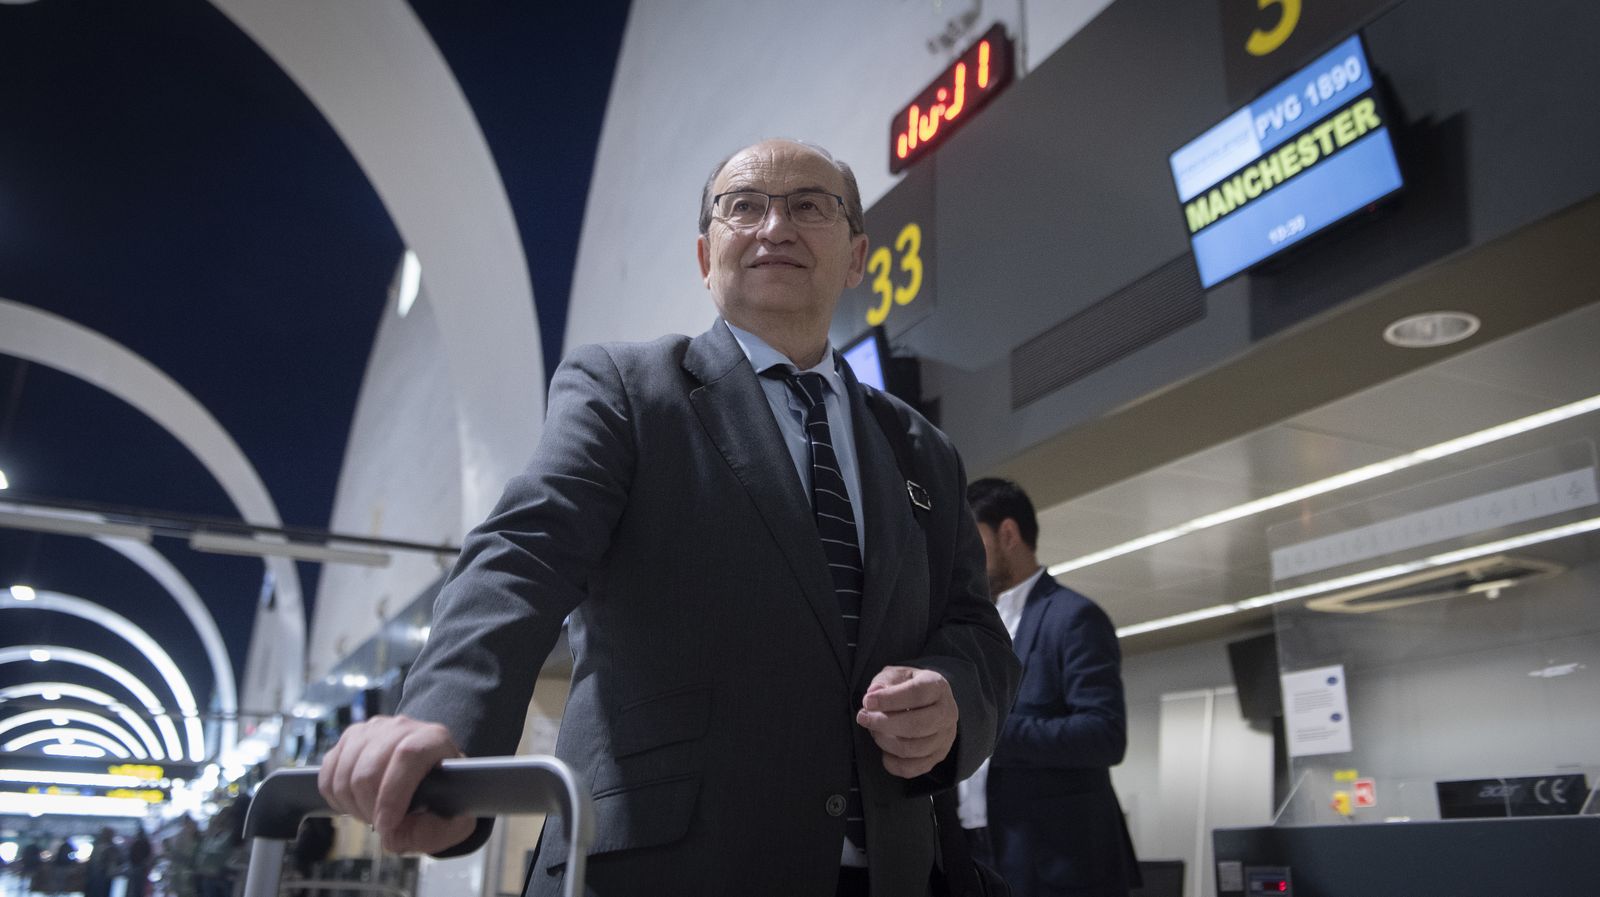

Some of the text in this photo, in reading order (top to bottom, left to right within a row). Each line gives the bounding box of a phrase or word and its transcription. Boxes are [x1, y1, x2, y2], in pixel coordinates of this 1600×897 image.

[1254, 55, 1362, 140] PVG 1890
[1185, 97, 1382, 234] MANCHESTER
[866, 223, 923, 326] 33
